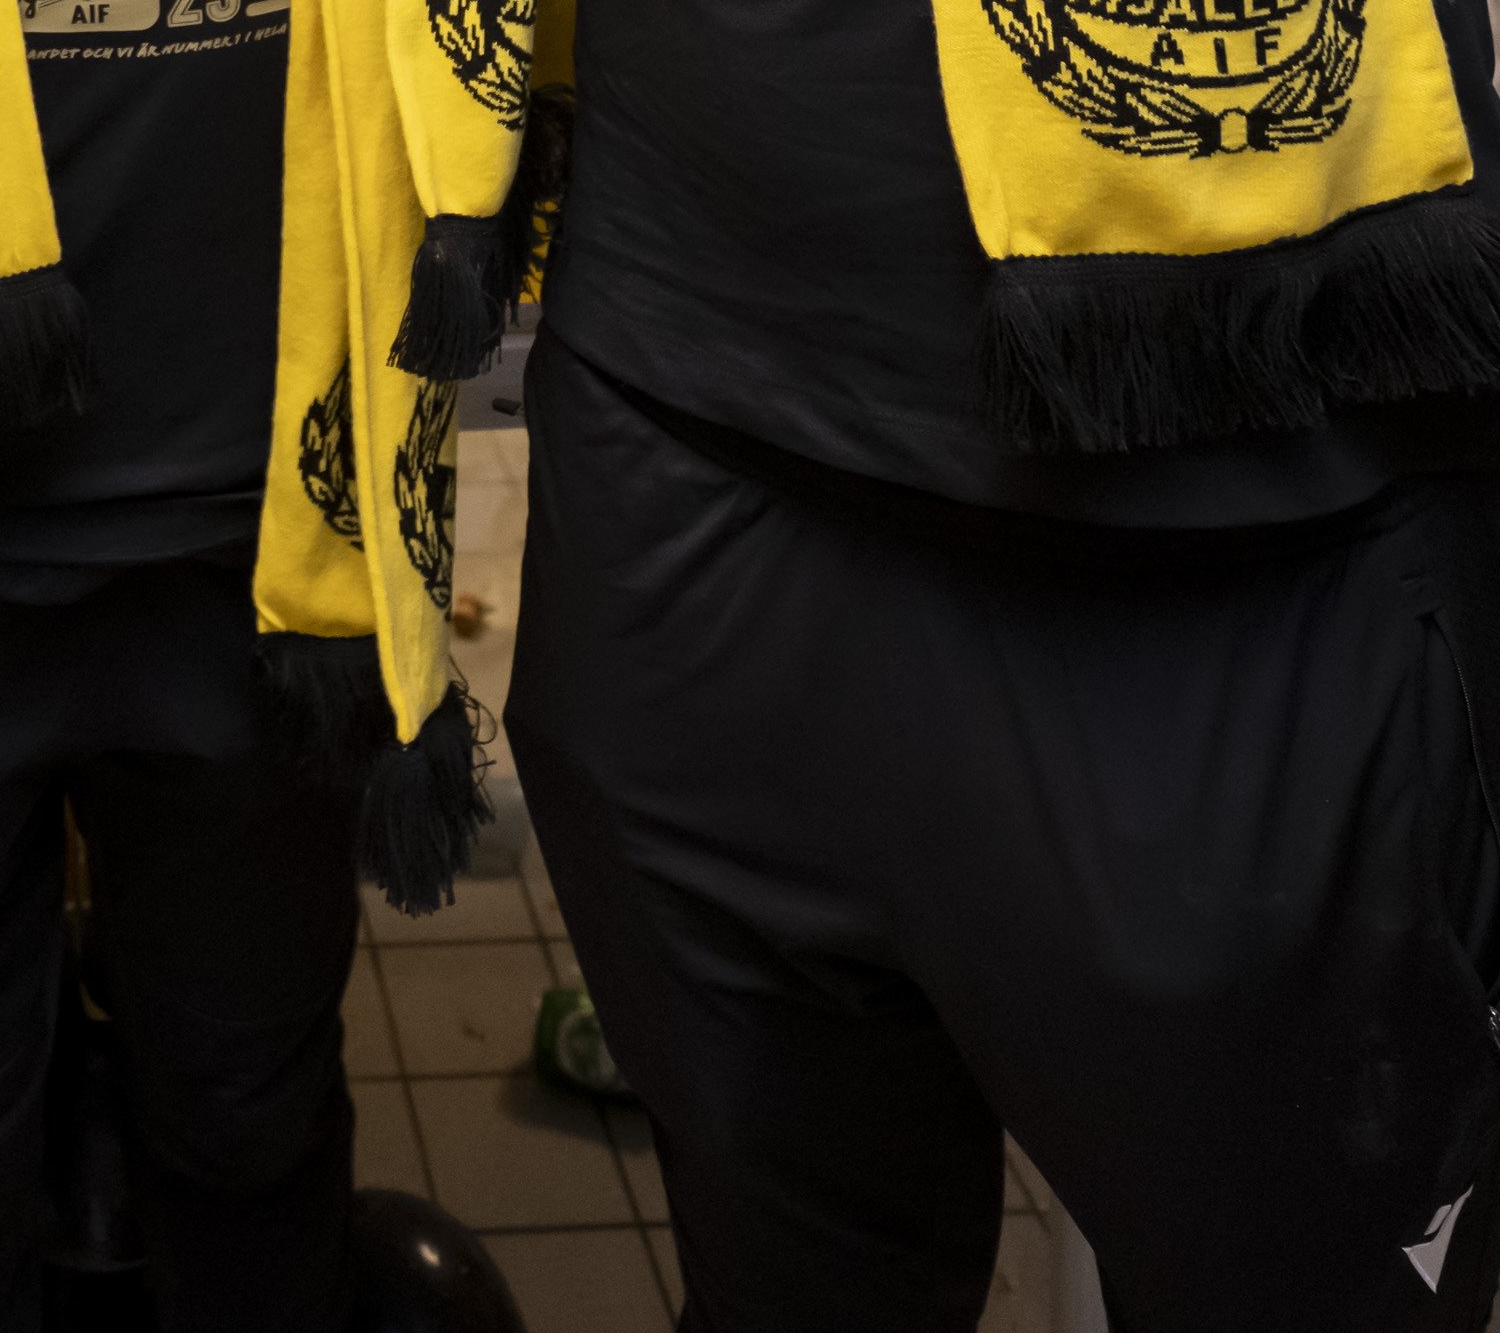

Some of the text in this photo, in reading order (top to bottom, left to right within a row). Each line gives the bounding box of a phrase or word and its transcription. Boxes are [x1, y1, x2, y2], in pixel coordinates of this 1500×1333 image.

[71, 4, 110, 25] AIF
[83, 47, 112, 60] OCH
[116, 46, 134, 59] VI
[136, 42, 161, 58] ÄR
[161, 36, 234, 55] NUMMER
[256, 23, 288, 41] HELA
[1151, 26, 1281, 74] AIF
